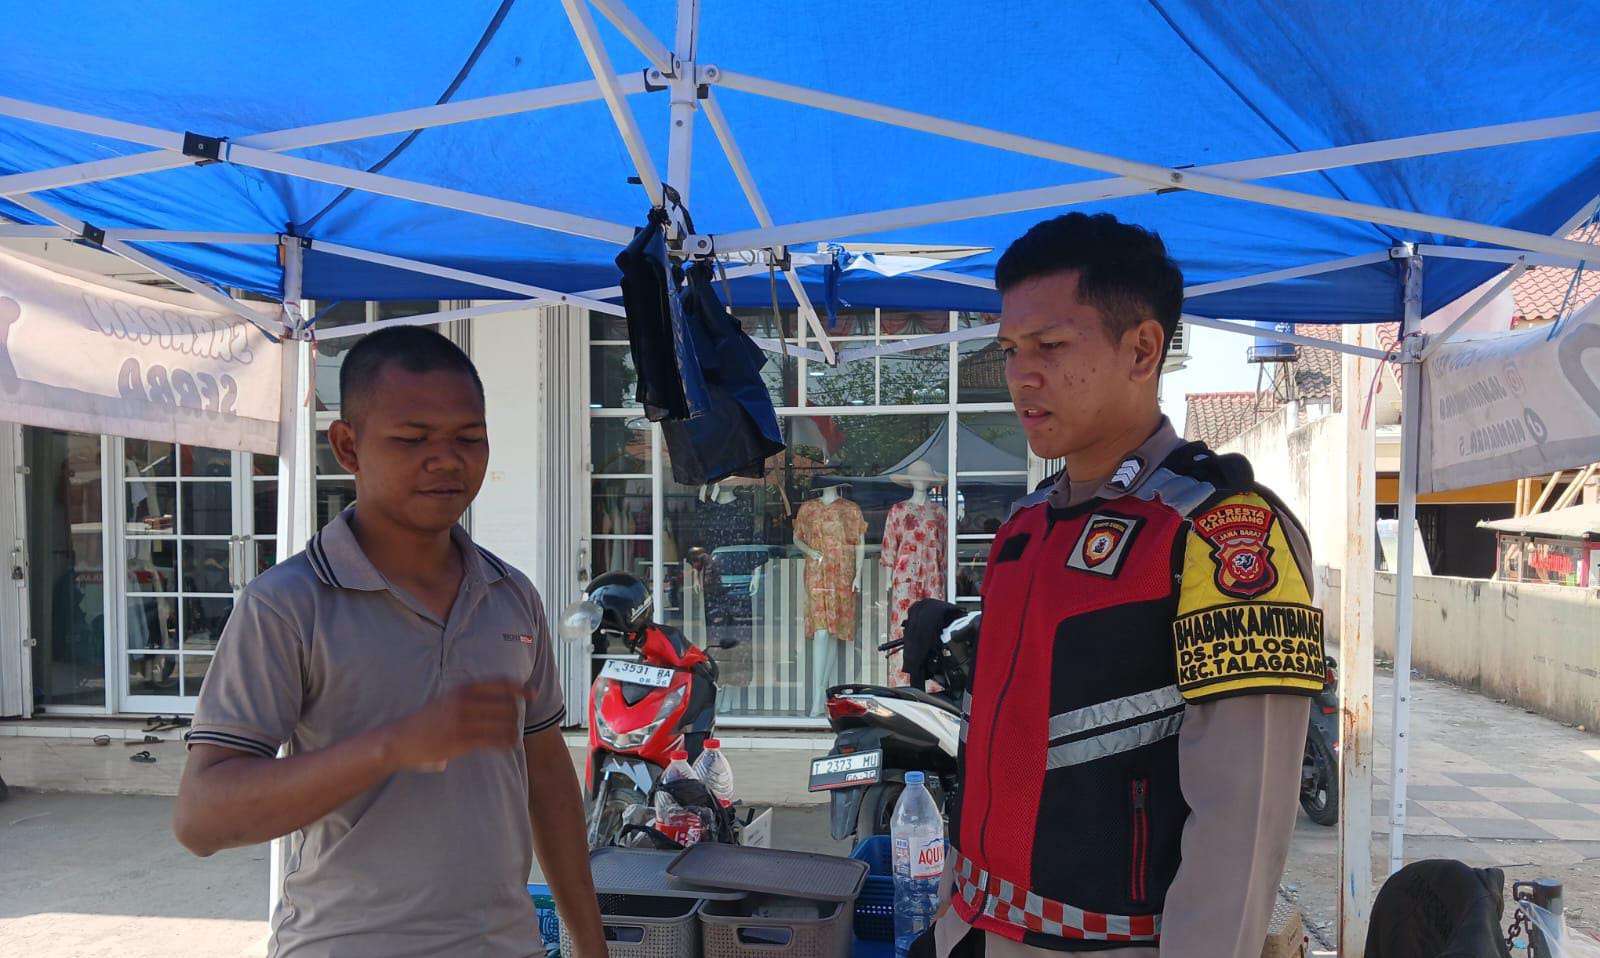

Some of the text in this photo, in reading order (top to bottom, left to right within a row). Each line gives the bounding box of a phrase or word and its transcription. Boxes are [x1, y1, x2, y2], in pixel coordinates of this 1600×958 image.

[1198, 507, 1265, 528] POLRESTA
[1204, 514, 1264, 532] KARAWANG
[608, 661, 615, 669] T
[621, 663, 649, 675] 3531
[815, 754, 878, 775] T 2373 MU
